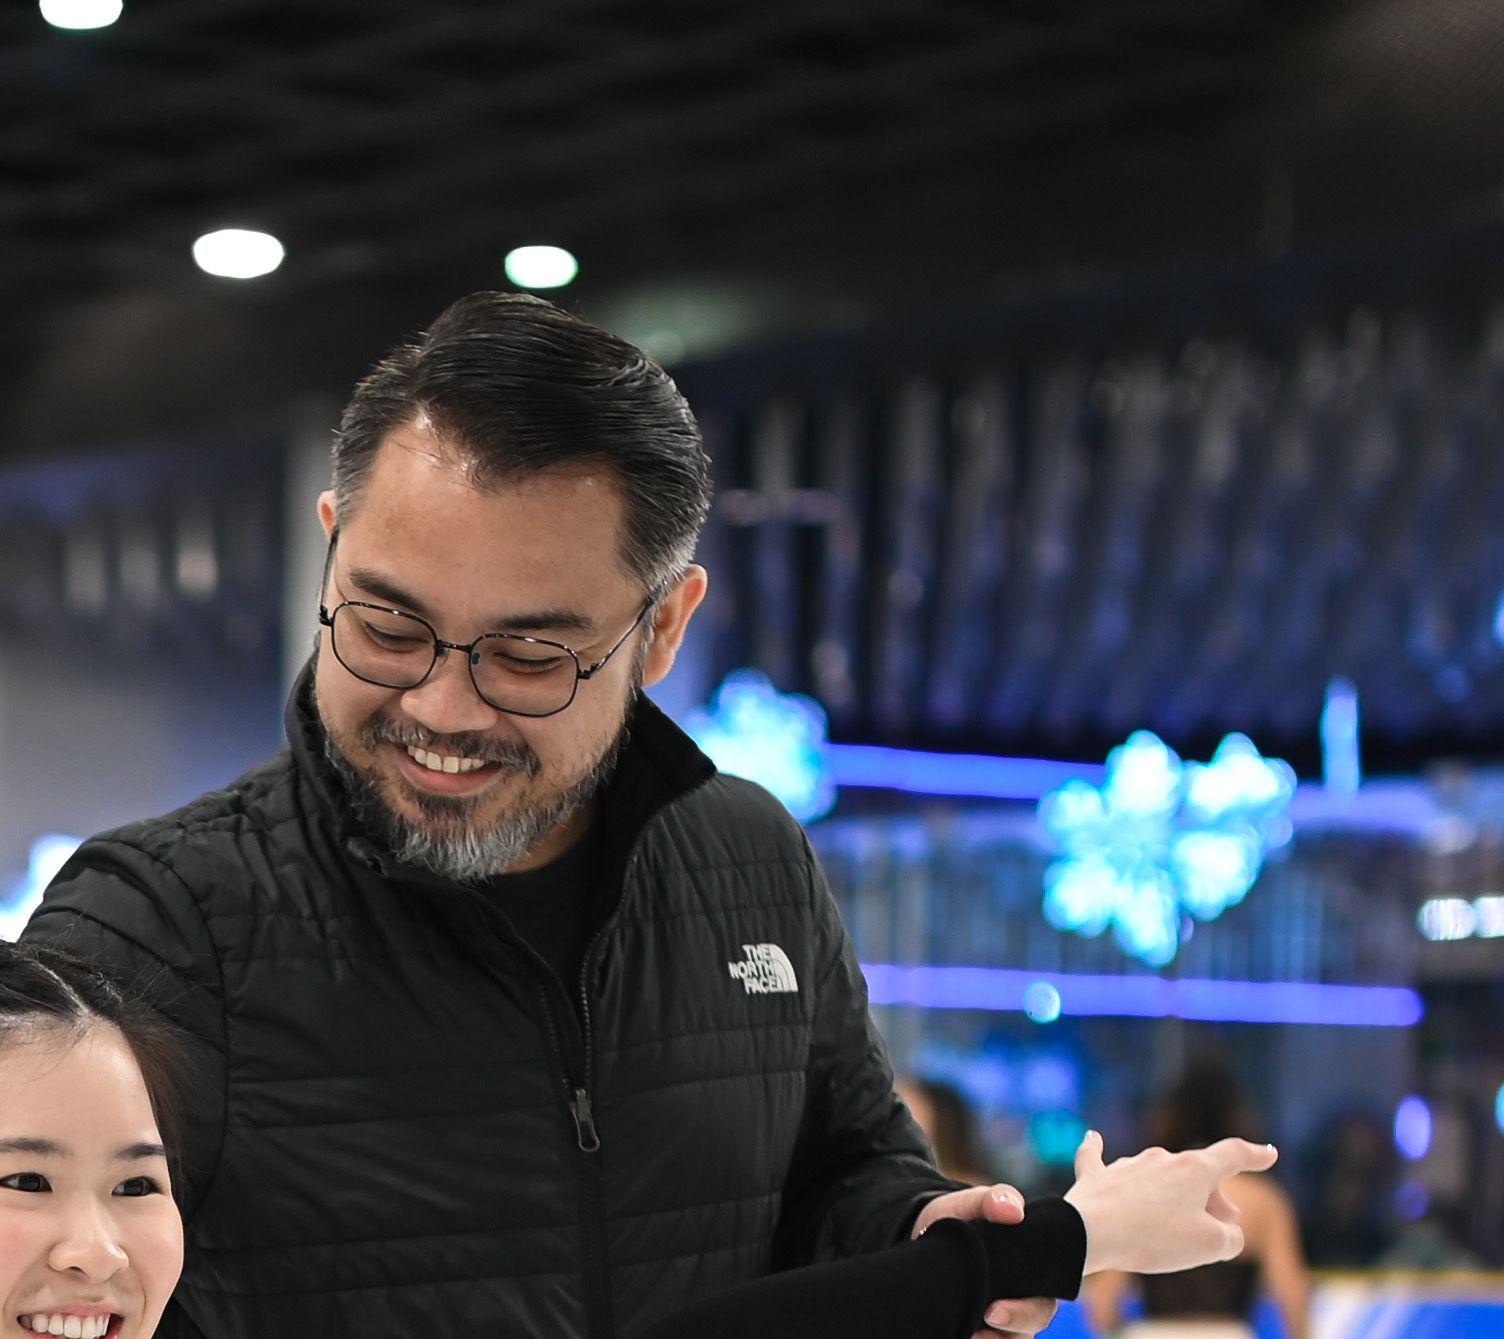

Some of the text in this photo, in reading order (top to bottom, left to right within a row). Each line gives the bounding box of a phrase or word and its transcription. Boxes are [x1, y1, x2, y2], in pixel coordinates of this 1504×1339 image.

[742, 944, 772, 960] THE
[728, 960, 776, 979] NORTH
[744, 977, 778, 994] FACE
